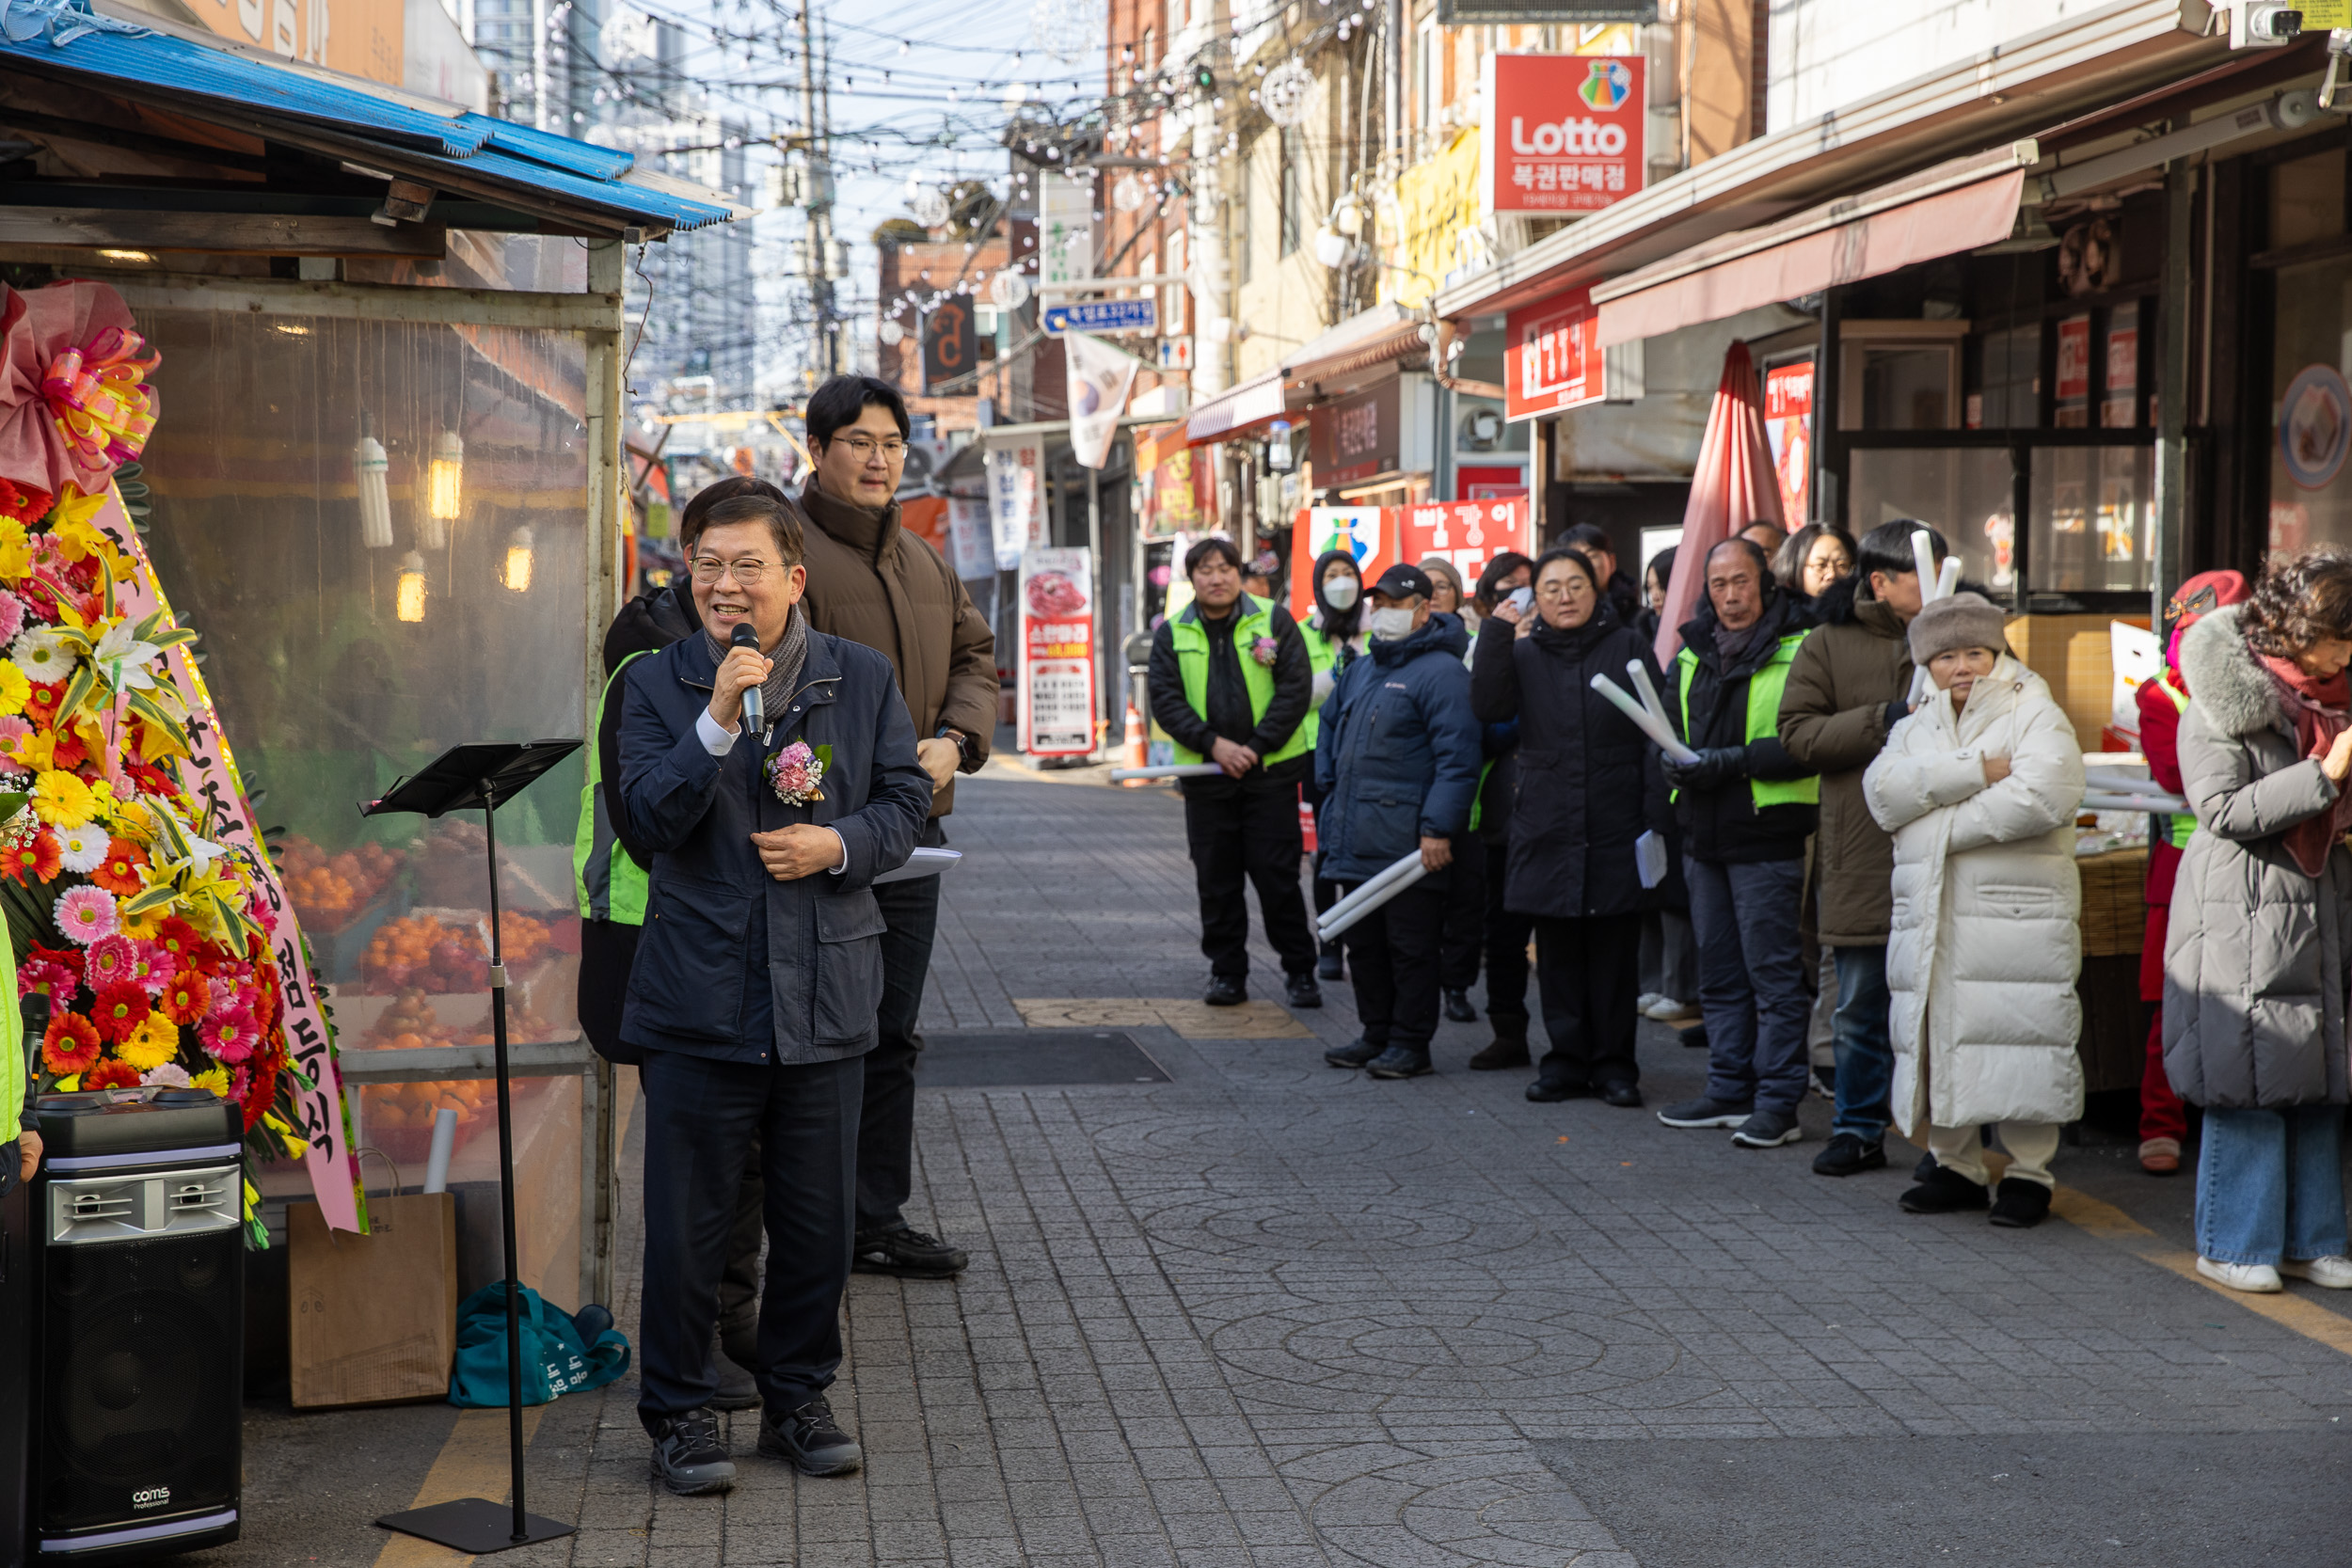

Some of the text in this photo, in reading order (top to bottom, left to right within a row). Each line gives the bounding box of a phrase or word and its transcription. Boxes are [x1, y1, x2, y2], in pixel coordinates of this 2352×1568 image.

[1511, 116, 1628, 156] Lotto
[1512, 164, 1626, 191] 복권판매점
[1413, 501, 1516, 548] 빨강이
[277, 938, 333, 1164] 점등식
[133, 1486, 170, 1503] coms
[134, 1498, 169, 1510] Professional
